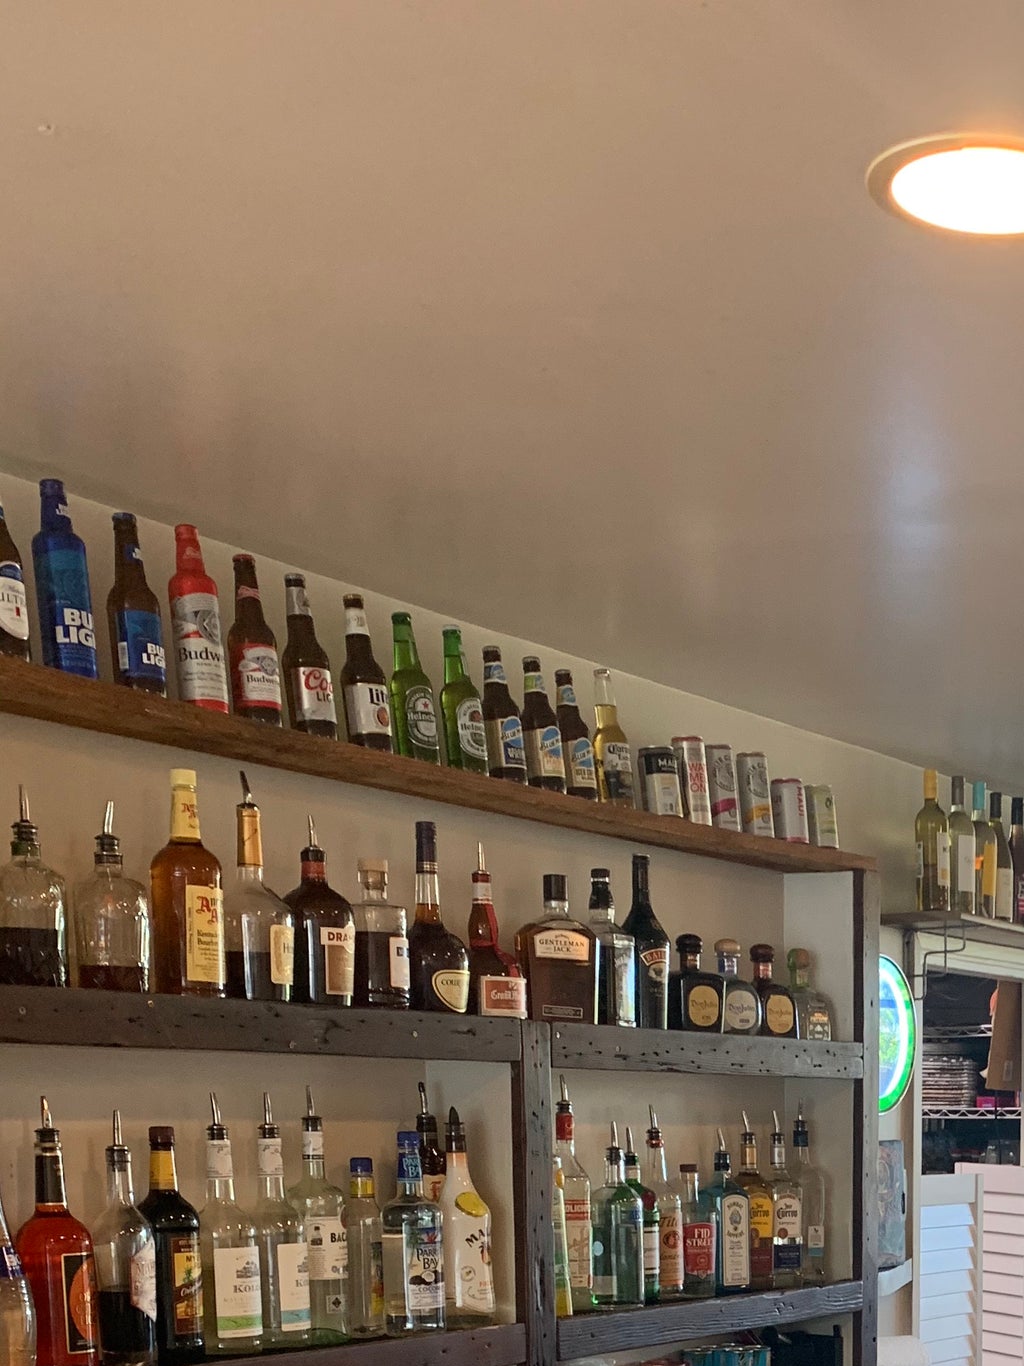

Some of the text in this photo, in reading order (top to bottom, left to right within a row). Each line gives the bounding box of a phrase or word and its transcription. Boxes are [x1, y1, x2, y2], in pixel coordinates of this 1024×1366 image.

[63, 607, 93, 631] BU
[179, 646, 222, 663] Budw
[539, 938, 585, 948] GENTLEMAN
